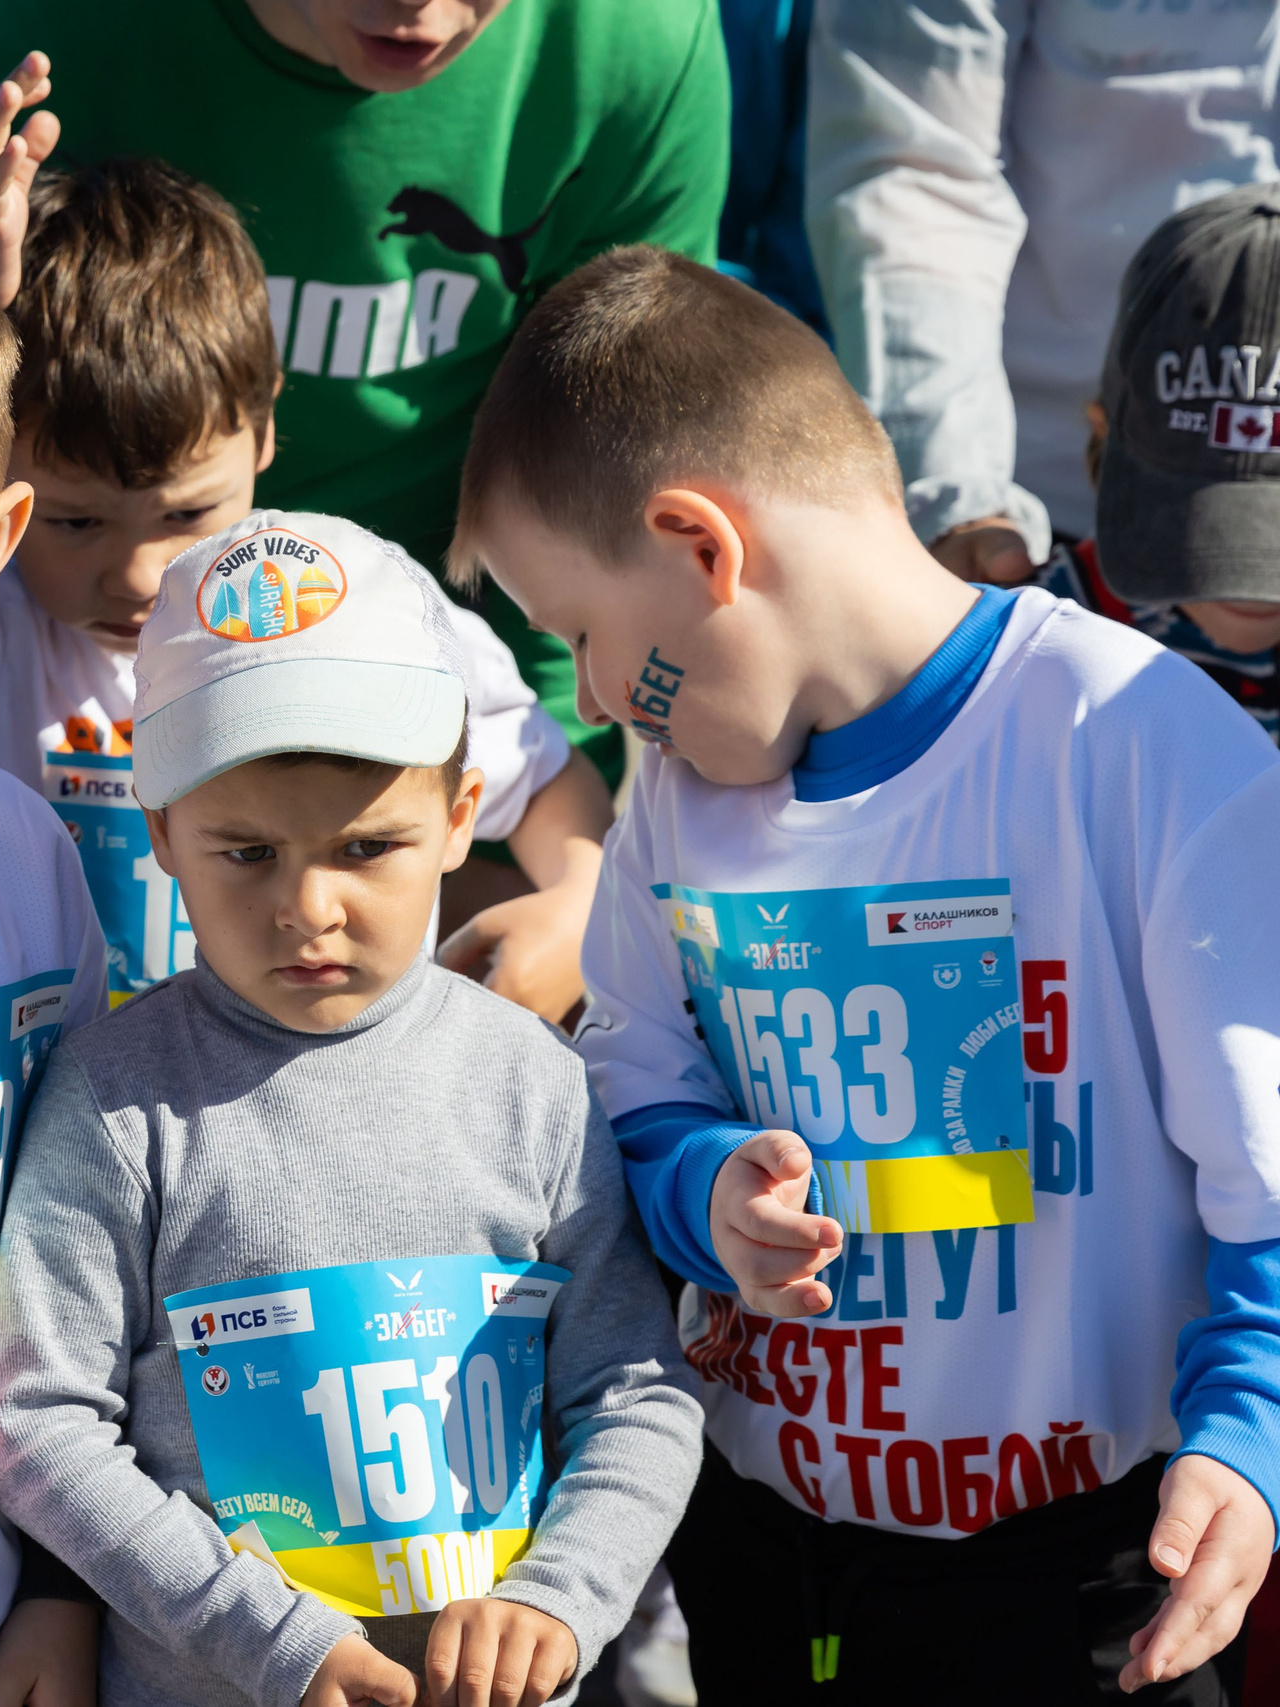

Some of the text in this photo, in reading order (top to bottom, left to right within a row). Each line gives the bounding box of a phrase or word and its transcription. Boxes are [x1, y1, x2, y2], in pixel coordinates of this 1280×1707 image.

[216, 537, 320, 578] SURF VIBES
[86, 782, 126, 798] ПСБ
[914, 907, 999, 921] КАЛАШНИКОВ
[914, 920, 953, 931] СПОРТ
[958, 1002, 1020, 1059] ЛЮБИ БЕГ
[719, 984, 917, 1145] 1533
[942, 1065, 967, 1118] РАМКИ
[945, 1118, 967, 1140] ЗА
[221, 1309, 267, 1332] ПСБ
[273, 1309, 298, 1318] сильной
[274, 1317, 297, 1325] страны
[302, 1353, 508, 1529] 1510
[778, 1420, 1101, 1533] С ТОБОЙ
[212, 1496, 244, 1519] БЕГУ
[243, 1493, 280, 1513] ВСЕМ
